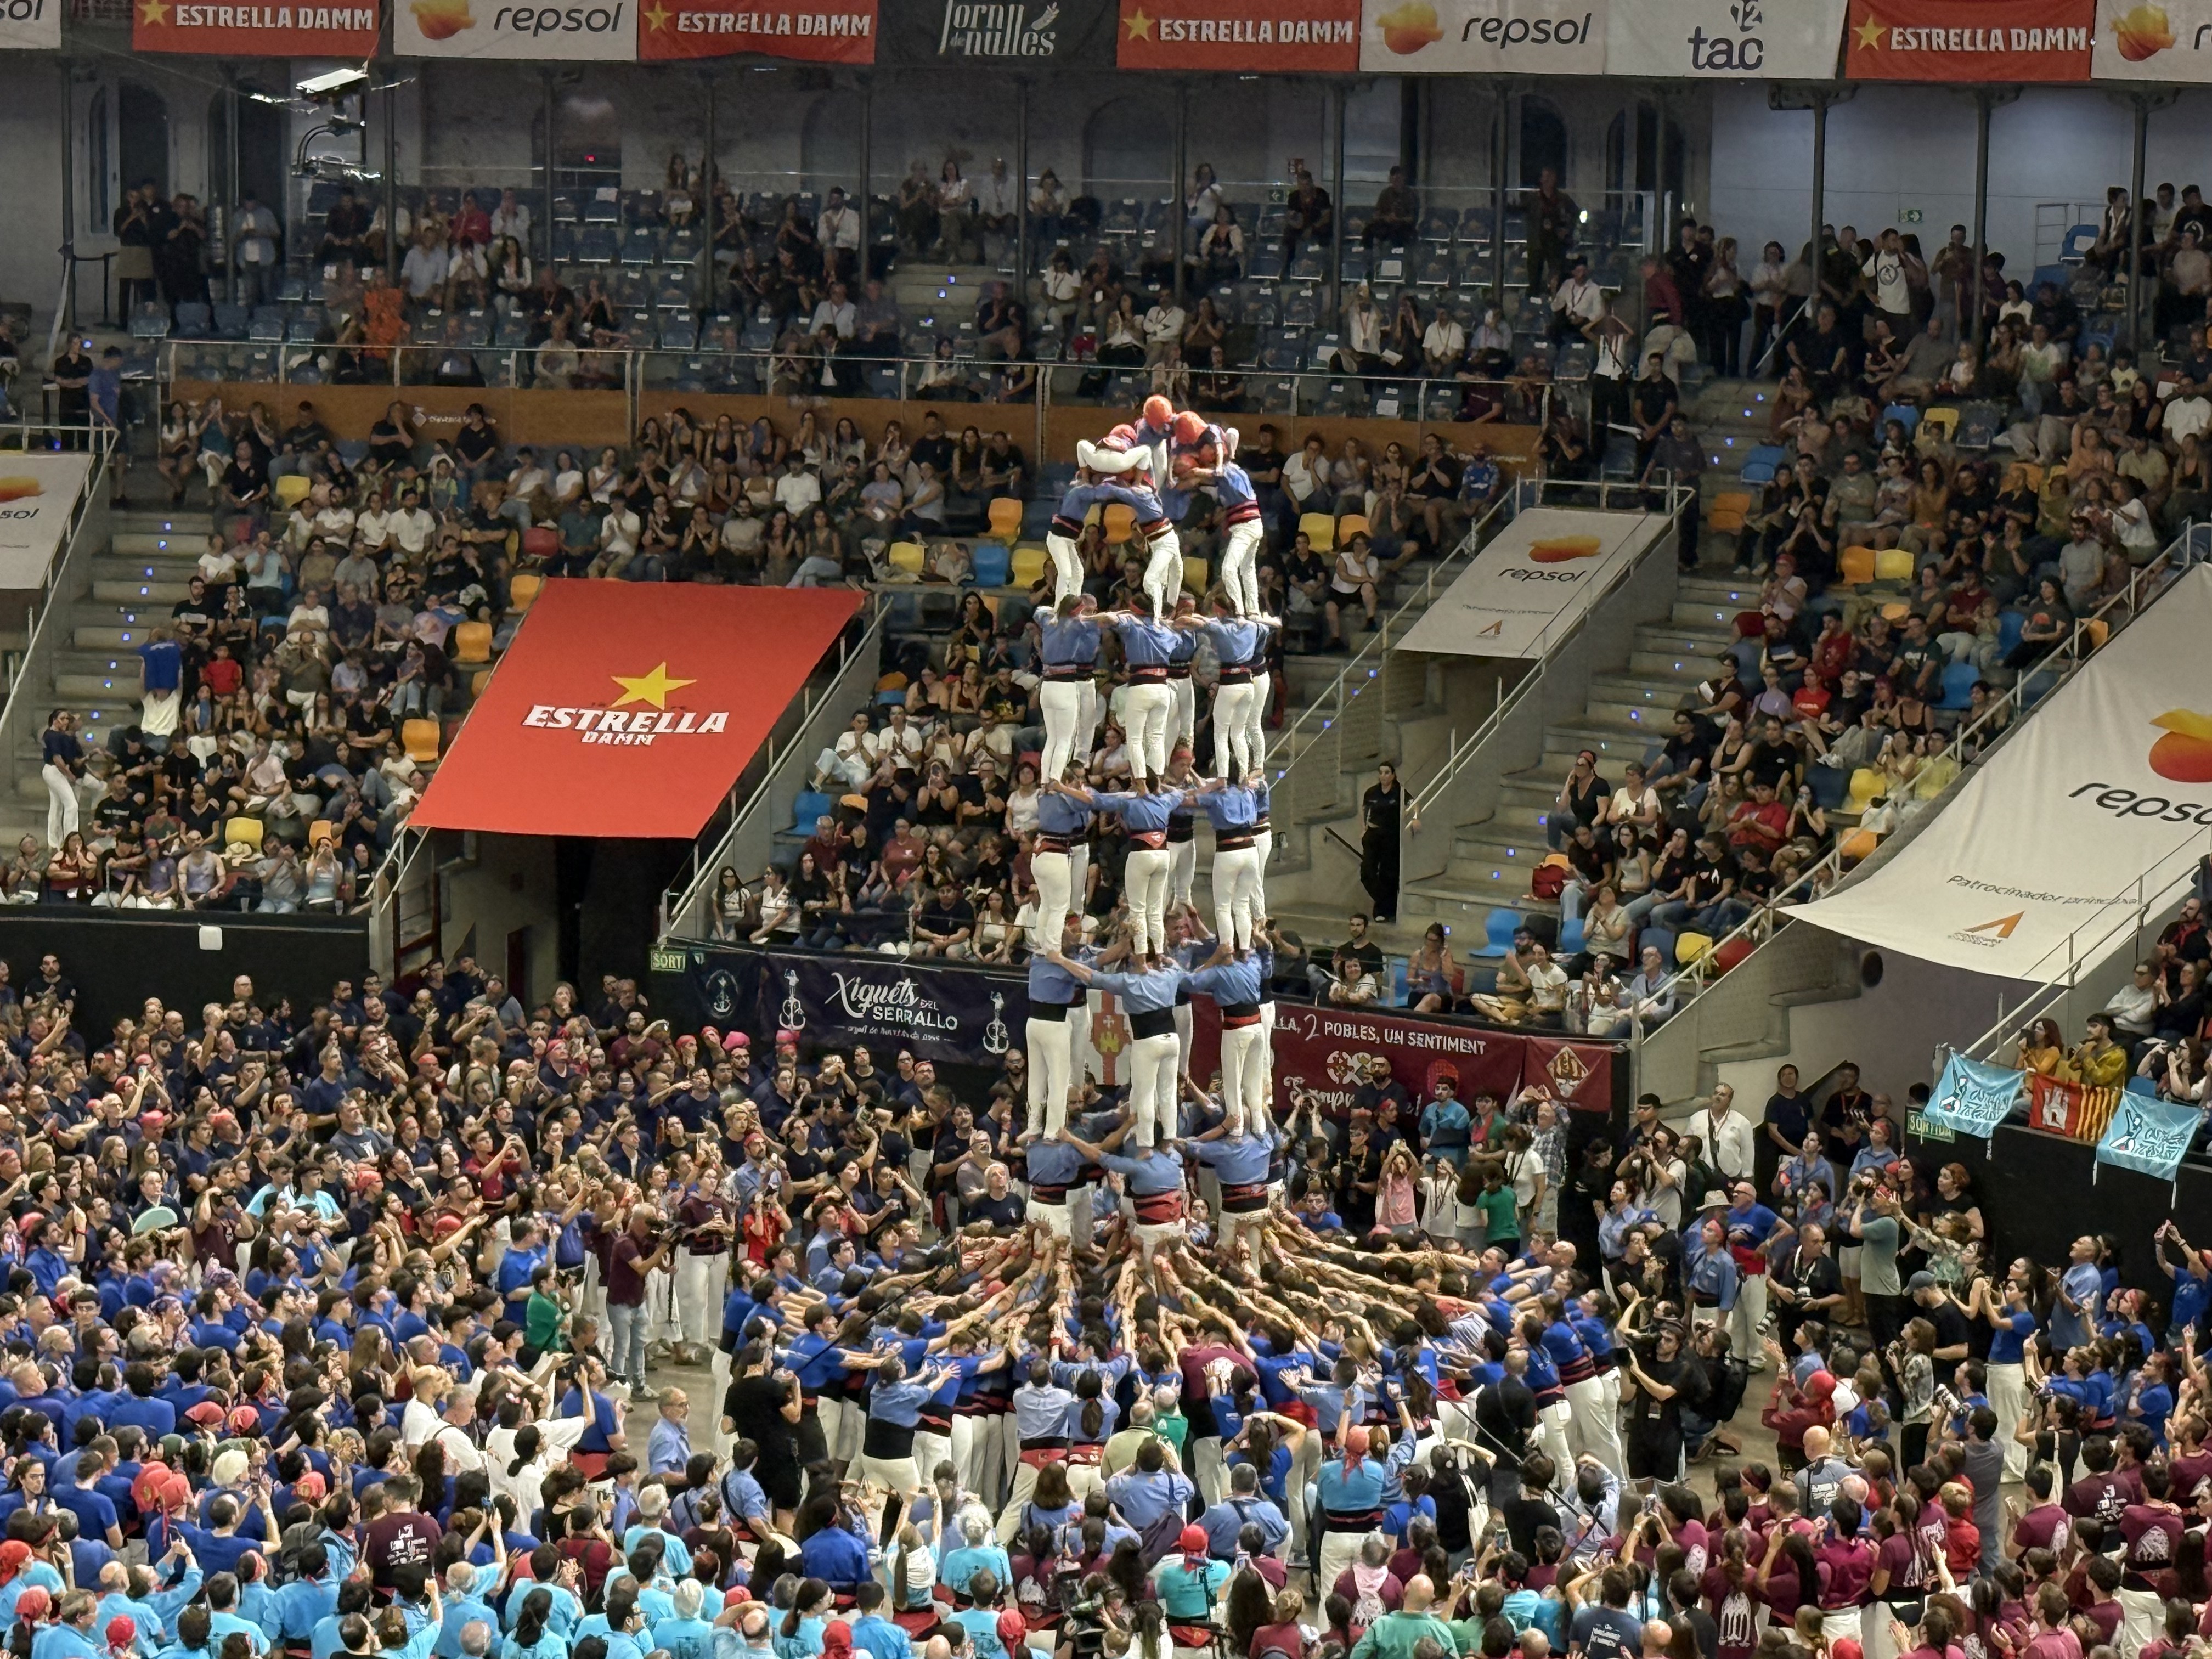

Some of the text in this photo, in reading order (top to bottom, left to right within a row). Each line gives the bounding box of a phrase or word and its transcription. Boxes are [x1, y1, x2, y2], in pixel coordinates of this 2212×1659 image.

[0, 0, 43, 20] ol
[176, 5, 373, 30] ESTRELLA DAMM
[494, 3, 623, 37] repsol
[678, 12, 871, 36] ESTRELLA DAMM
[1159, 19, 1353, 43] ESTRELLA DAMM
[1462, 13, 1592, 49] repsol
[1688, 26, 1763, 70] tac
[1891, 27, 2086, 52] ESTRELLA DAMM
[1498, 568, 1587, 582] repsol
[522, 704, 729, 733] ESTRELLA
[581, 731, 656, 746] DAMM
[825, 972, 919, 1018] Xiquets
[873, 1006, 958, 1030] SERRALLO
[1304, 1014, 1320, 1041] 2
[1324, 1021, 1380, 1044] POBLES,
[1384, 1028, 1403, 1045] UN
[1407, 1032, 1486, 1055] SENTIMENT
